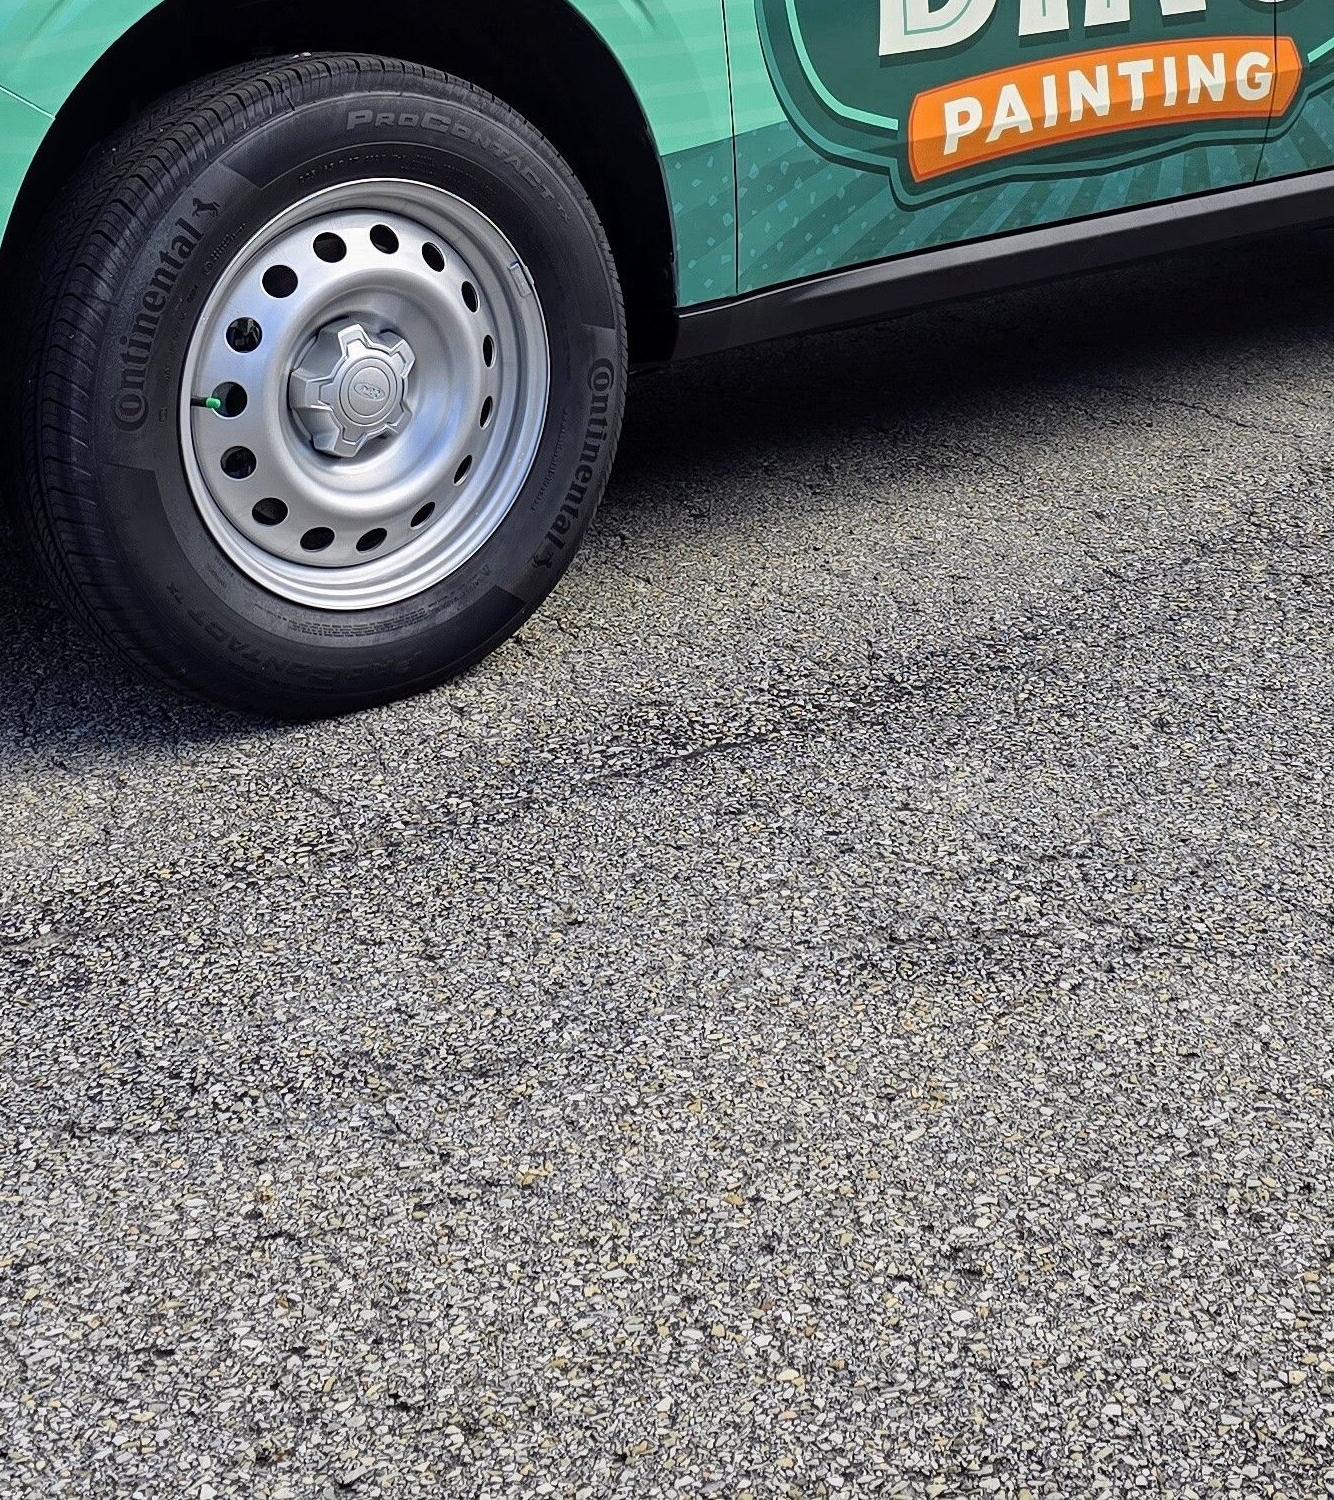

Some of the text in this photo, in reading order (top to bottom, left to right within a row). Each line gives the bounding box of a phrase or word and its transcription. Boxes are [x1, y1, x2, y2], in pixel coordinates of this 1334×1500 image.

[943, 52, 1274, 156] PAINTING
[116, 217, 205, 433] Continental
[544, 357, 615, 549] Continental
